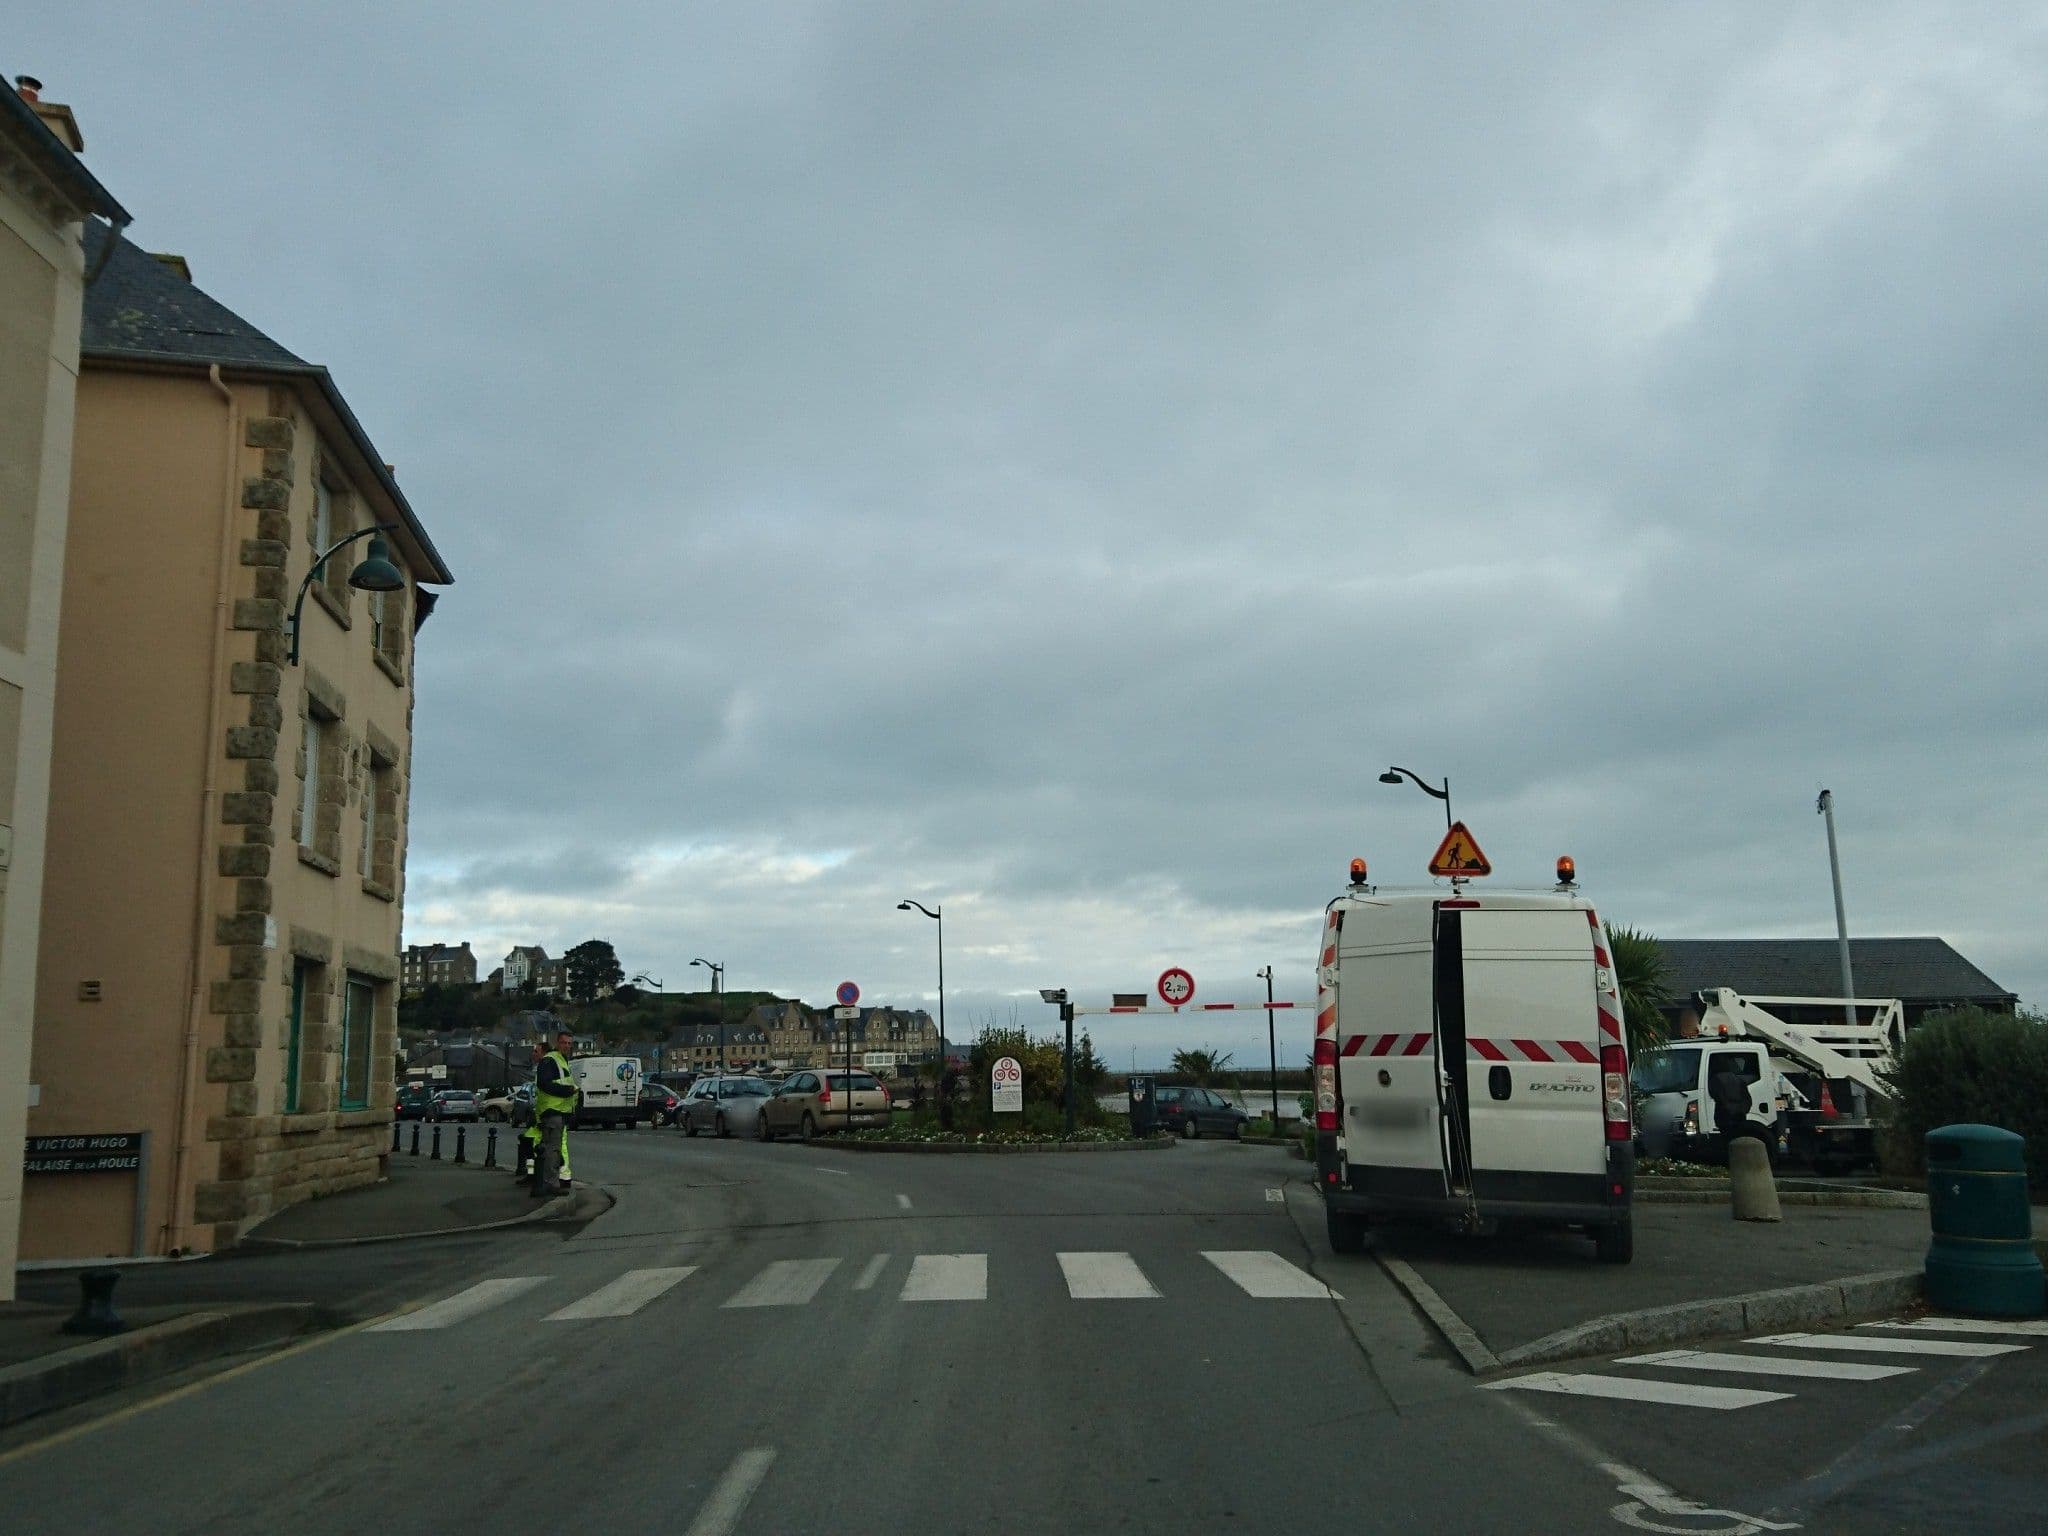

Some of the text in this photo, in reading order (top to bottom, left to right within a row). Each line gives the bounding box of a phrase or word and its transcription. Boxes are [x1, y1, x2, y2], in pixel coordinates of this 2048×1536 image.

[1164, 981, 1188, 993] 2,2m
[1529, 1082, 1595, 1093] DUCATO
[36, 1139, 86, 1150] VICTOR
[90, 1137, 128, 1149] HUGO
[98, 1157, 139, 1168] HOULE
